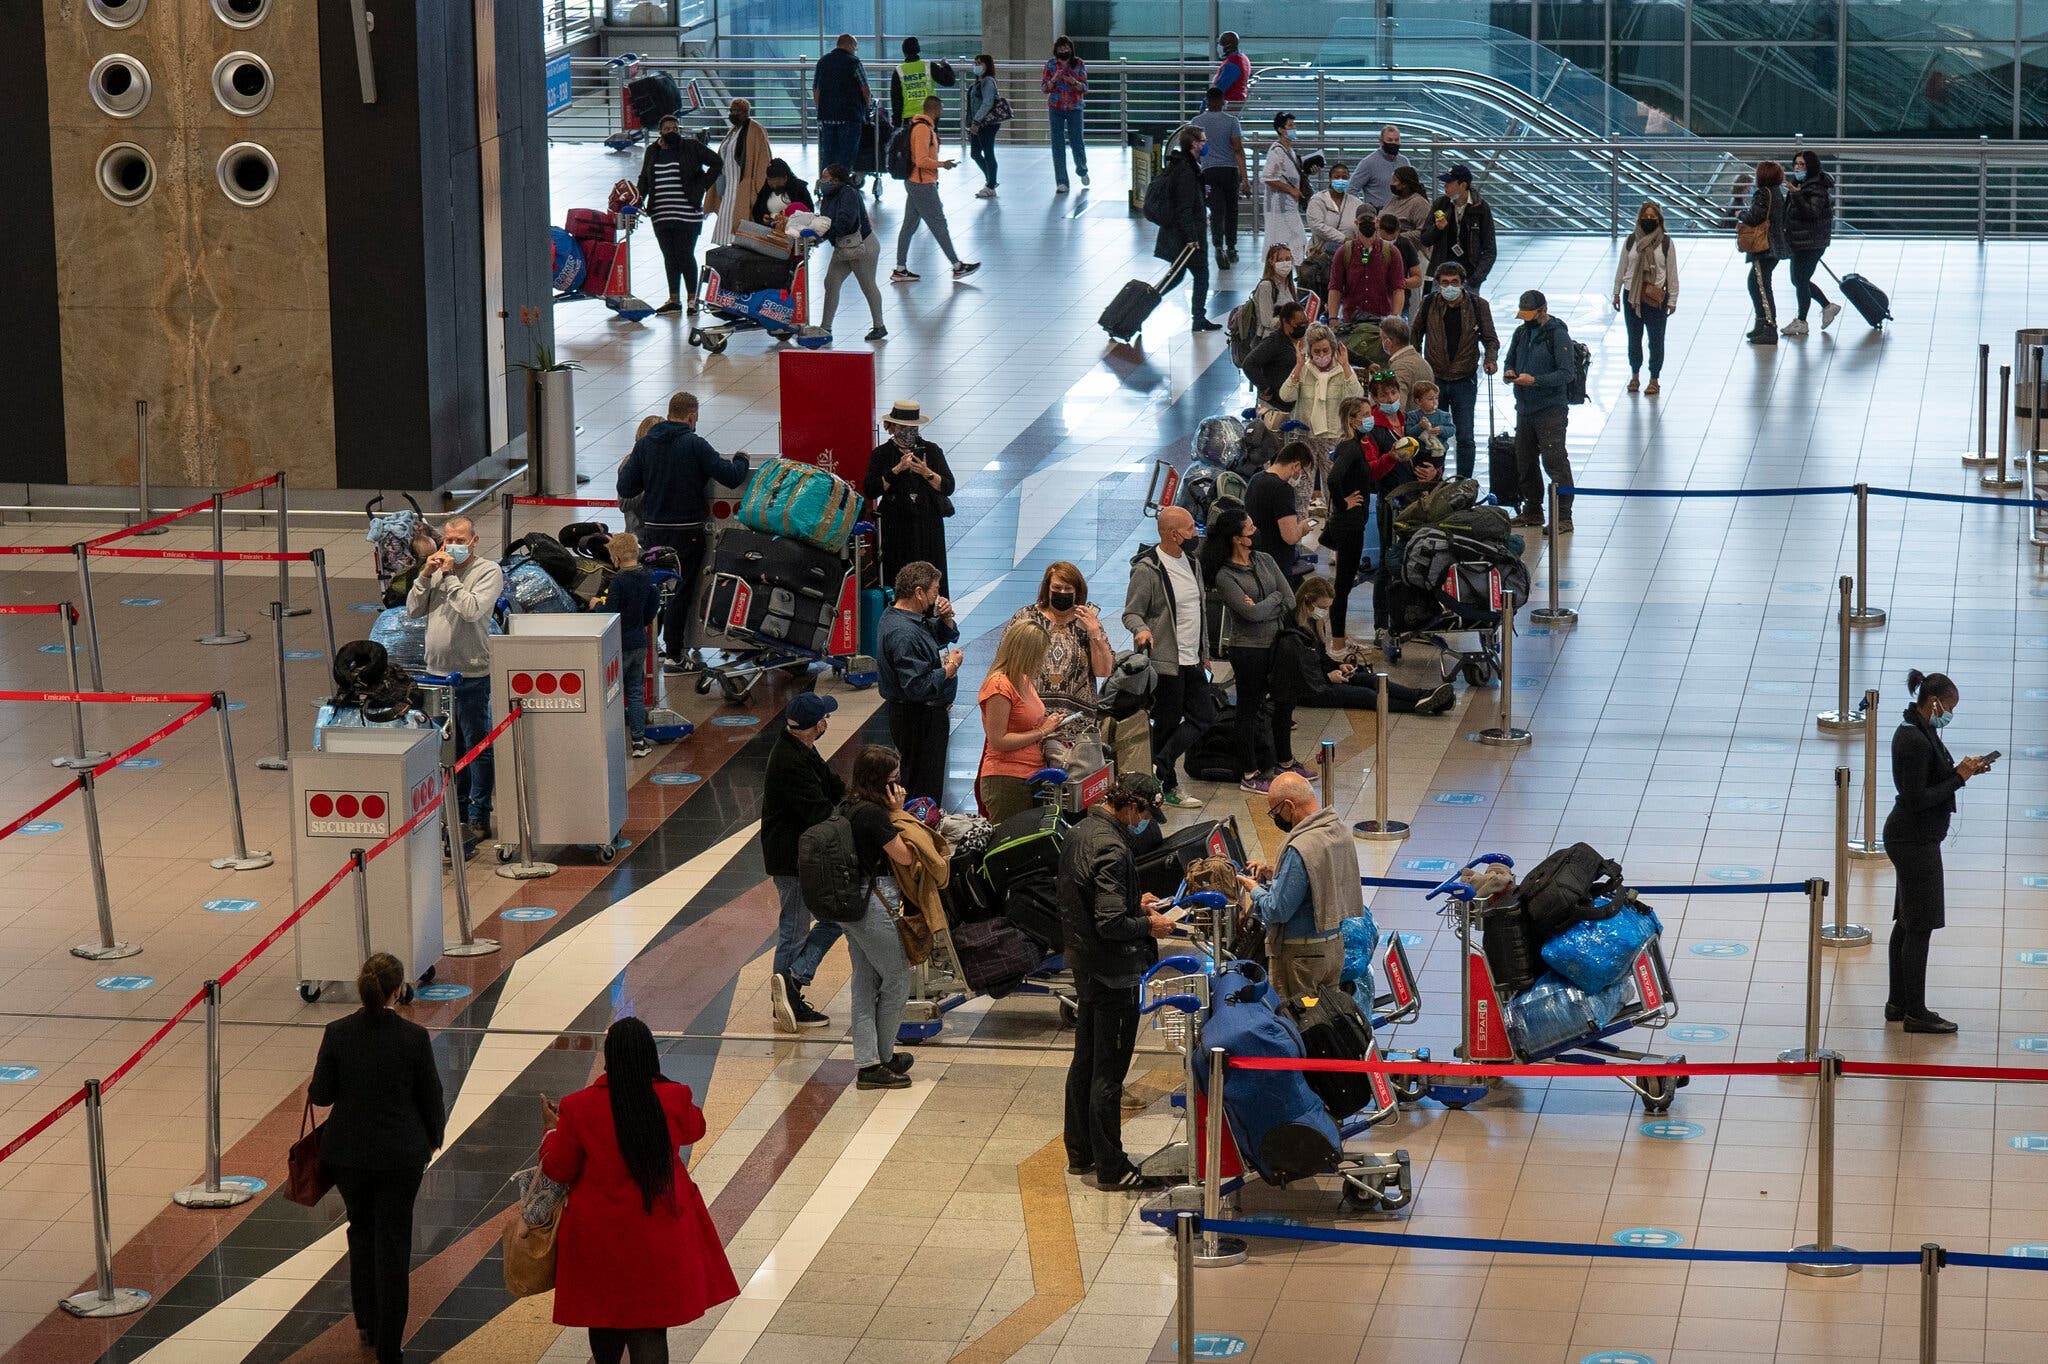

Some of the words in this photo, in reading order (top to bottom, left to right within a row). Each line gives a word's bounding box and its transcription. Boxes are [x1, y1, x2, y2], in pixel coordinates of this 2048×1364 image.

[904, 73, 926, 82] MSP
[20, 545, 45, 554] Emirates
[87, 548, 110, 556] Emirates
[240, 553, 263, 561] Emirates
[44, 692, 71, 701] Emirates
[131, 694, 159, 702] Emirates
[521, 697, 582, 710] ECURITAS
[311, 820, 386, 836] SECURITAS
